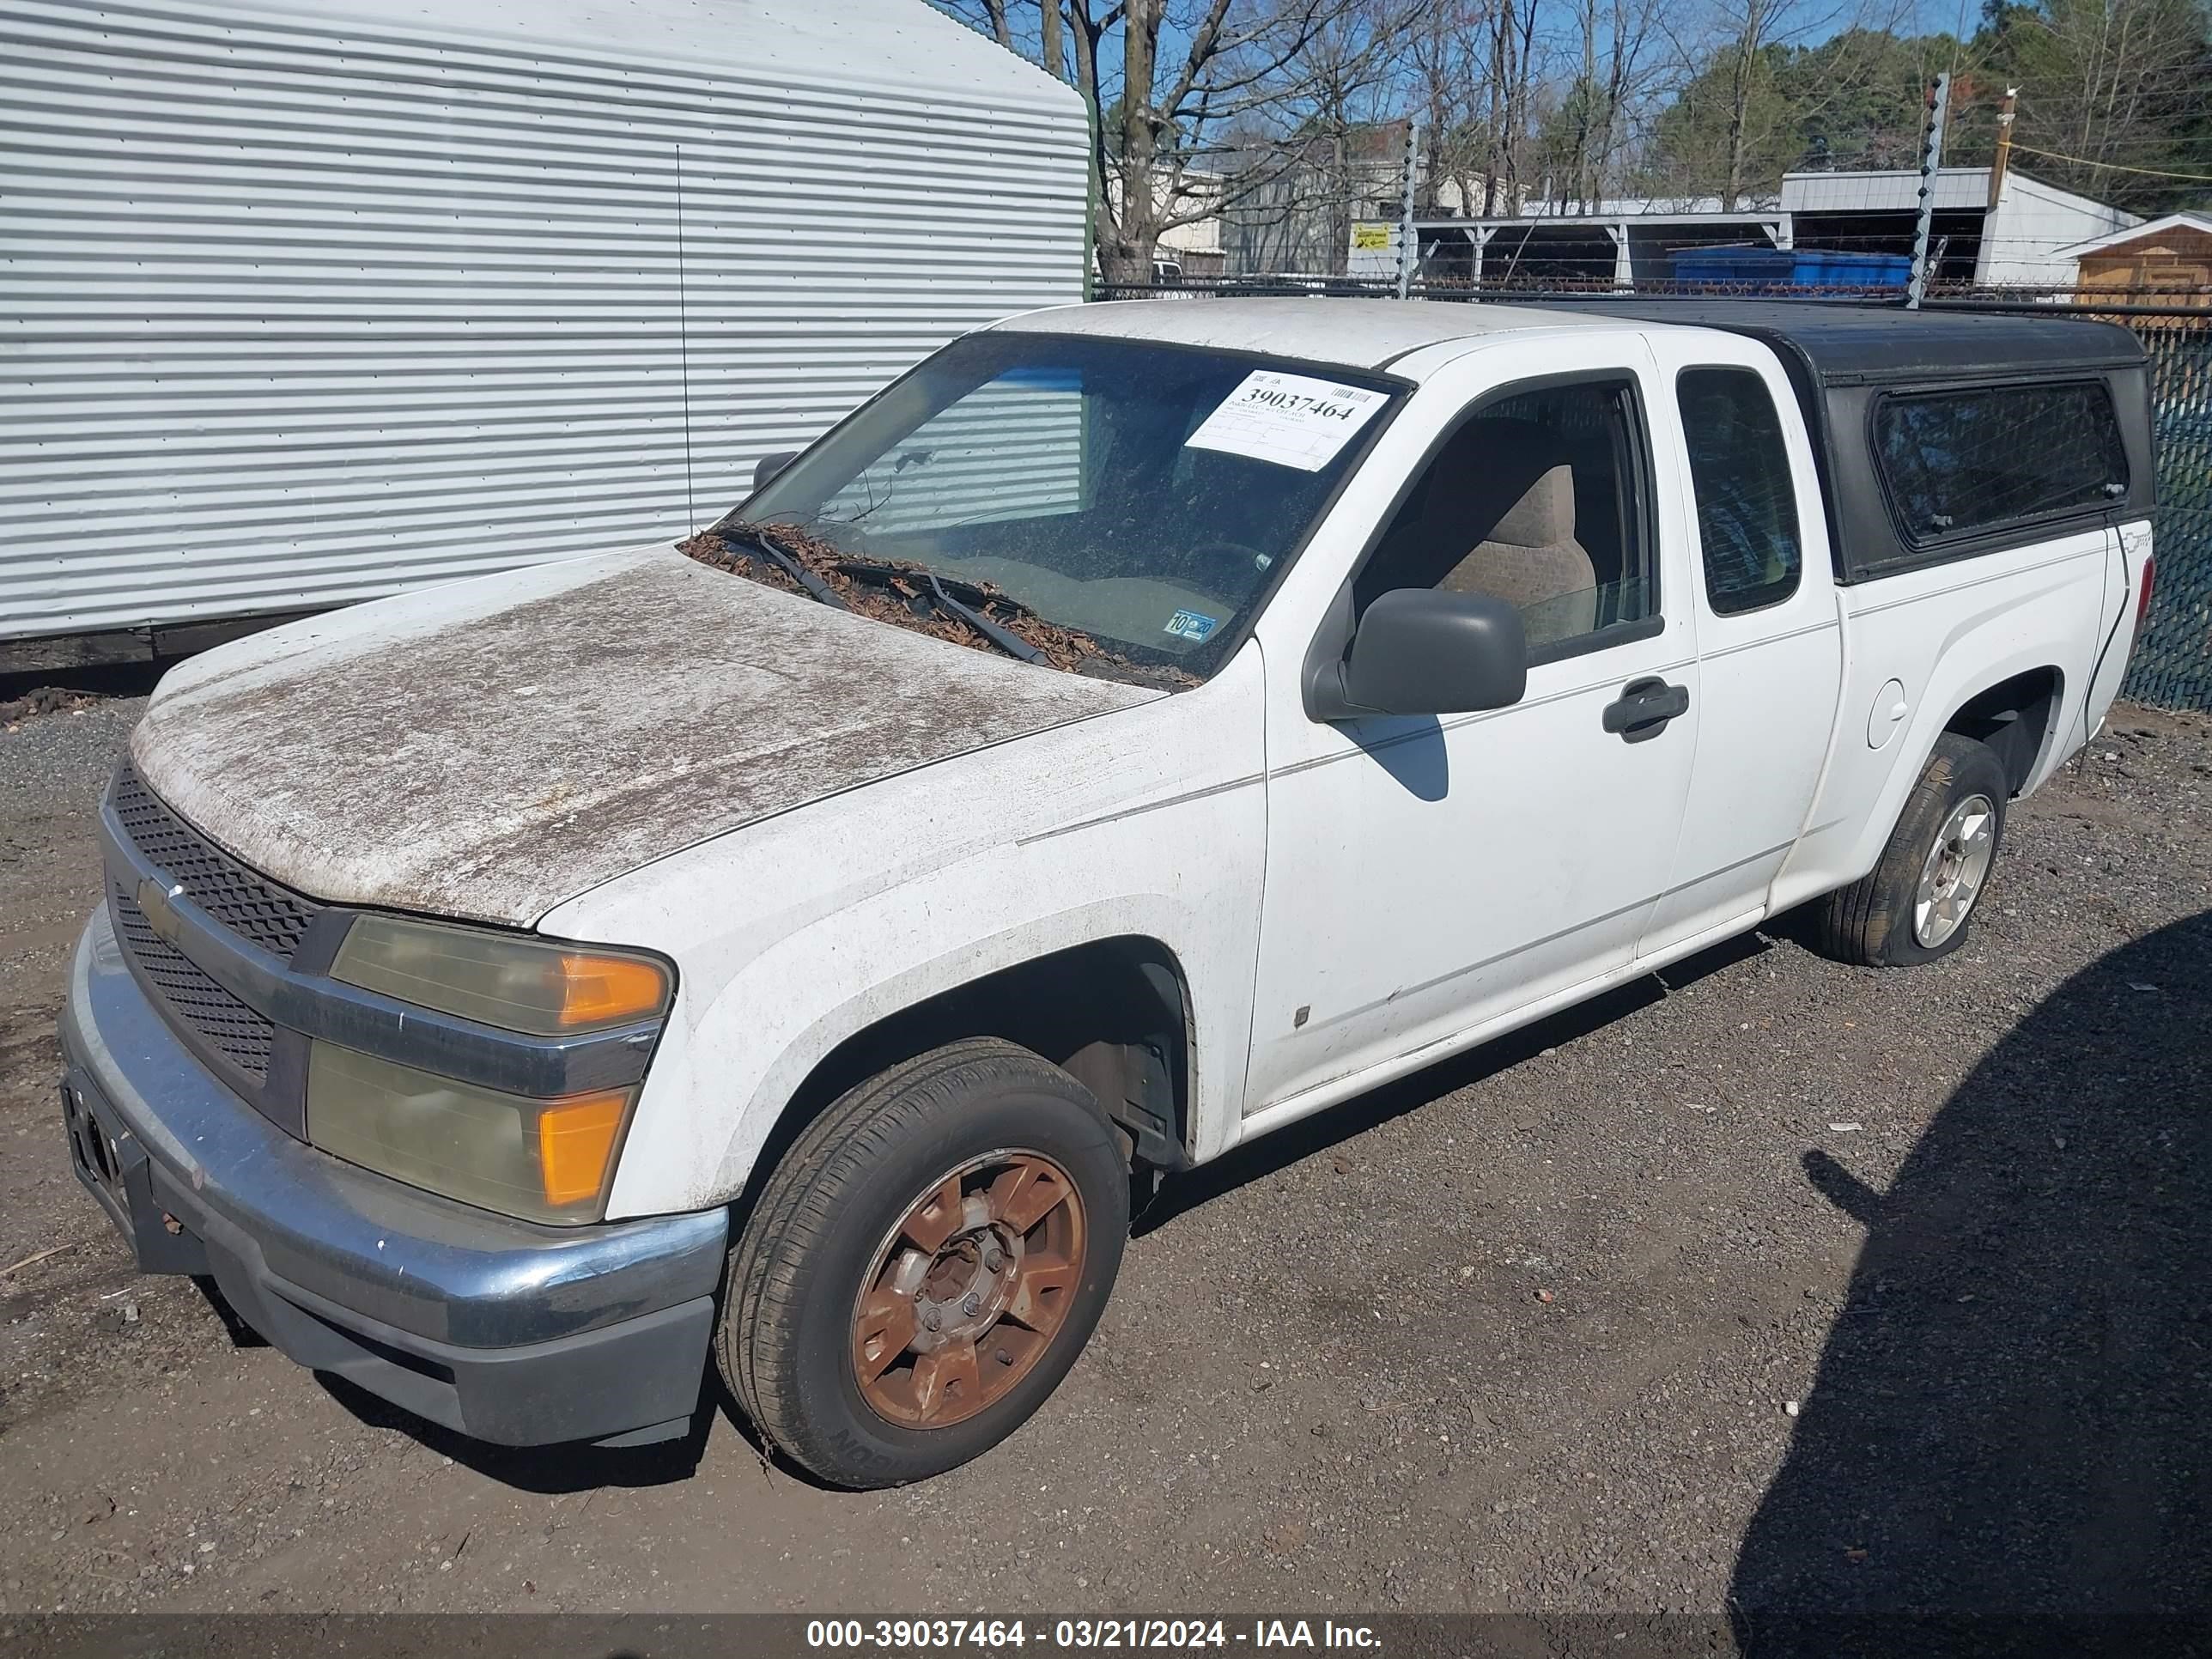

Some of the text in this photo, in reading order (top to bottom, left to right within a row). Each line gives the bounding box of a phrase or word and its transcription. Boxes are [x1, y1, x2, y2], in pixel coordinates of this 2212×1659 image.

[1242, 387, 1357, 421] 39037464
[1170, 615, 1188, 630] 10
[1195, 621, 1212, 634] 20
